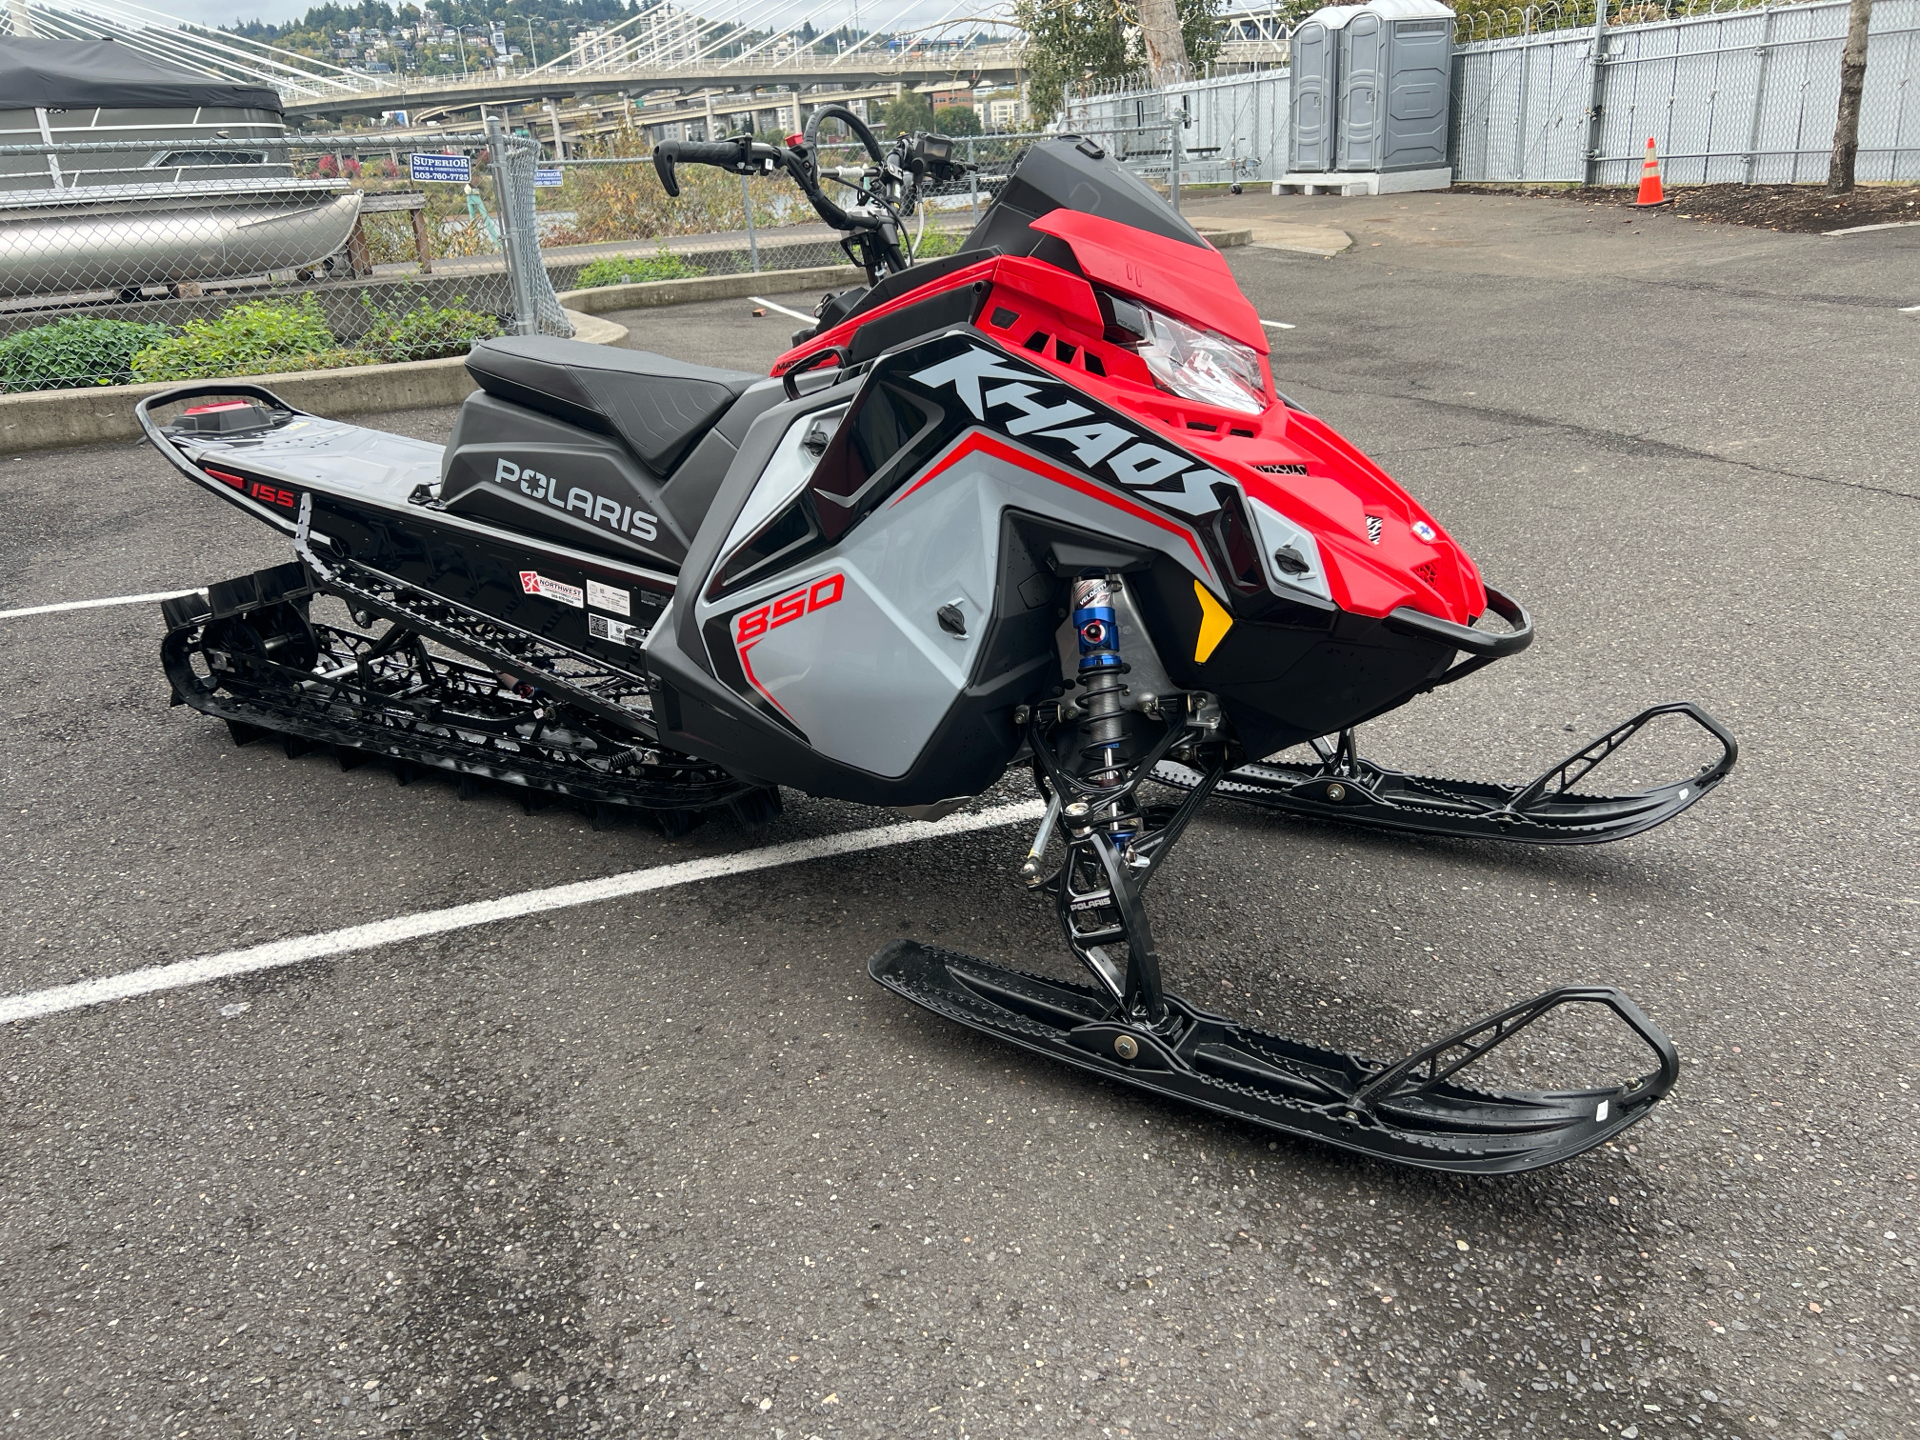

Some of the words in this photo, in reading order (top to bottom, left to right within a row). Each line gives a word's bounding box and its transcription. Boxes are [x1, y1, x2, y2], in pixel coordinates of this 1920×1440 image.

[413, 155, 468, 168] SUPERIOR
[414, 171, 469, 181] 503-760-7725
[908, 343, 1235, 516] KHAOS
[251, 482, 294, 508] 155
[494, 457, 658, 542] POLARIS
[539, 579, 582, 596] NORTHWEST
[1079, 581, 1107, 606] VELOCITY
[736, 572, 846, 645] 850
[1069, 896, 1111, 912] POLARIS
